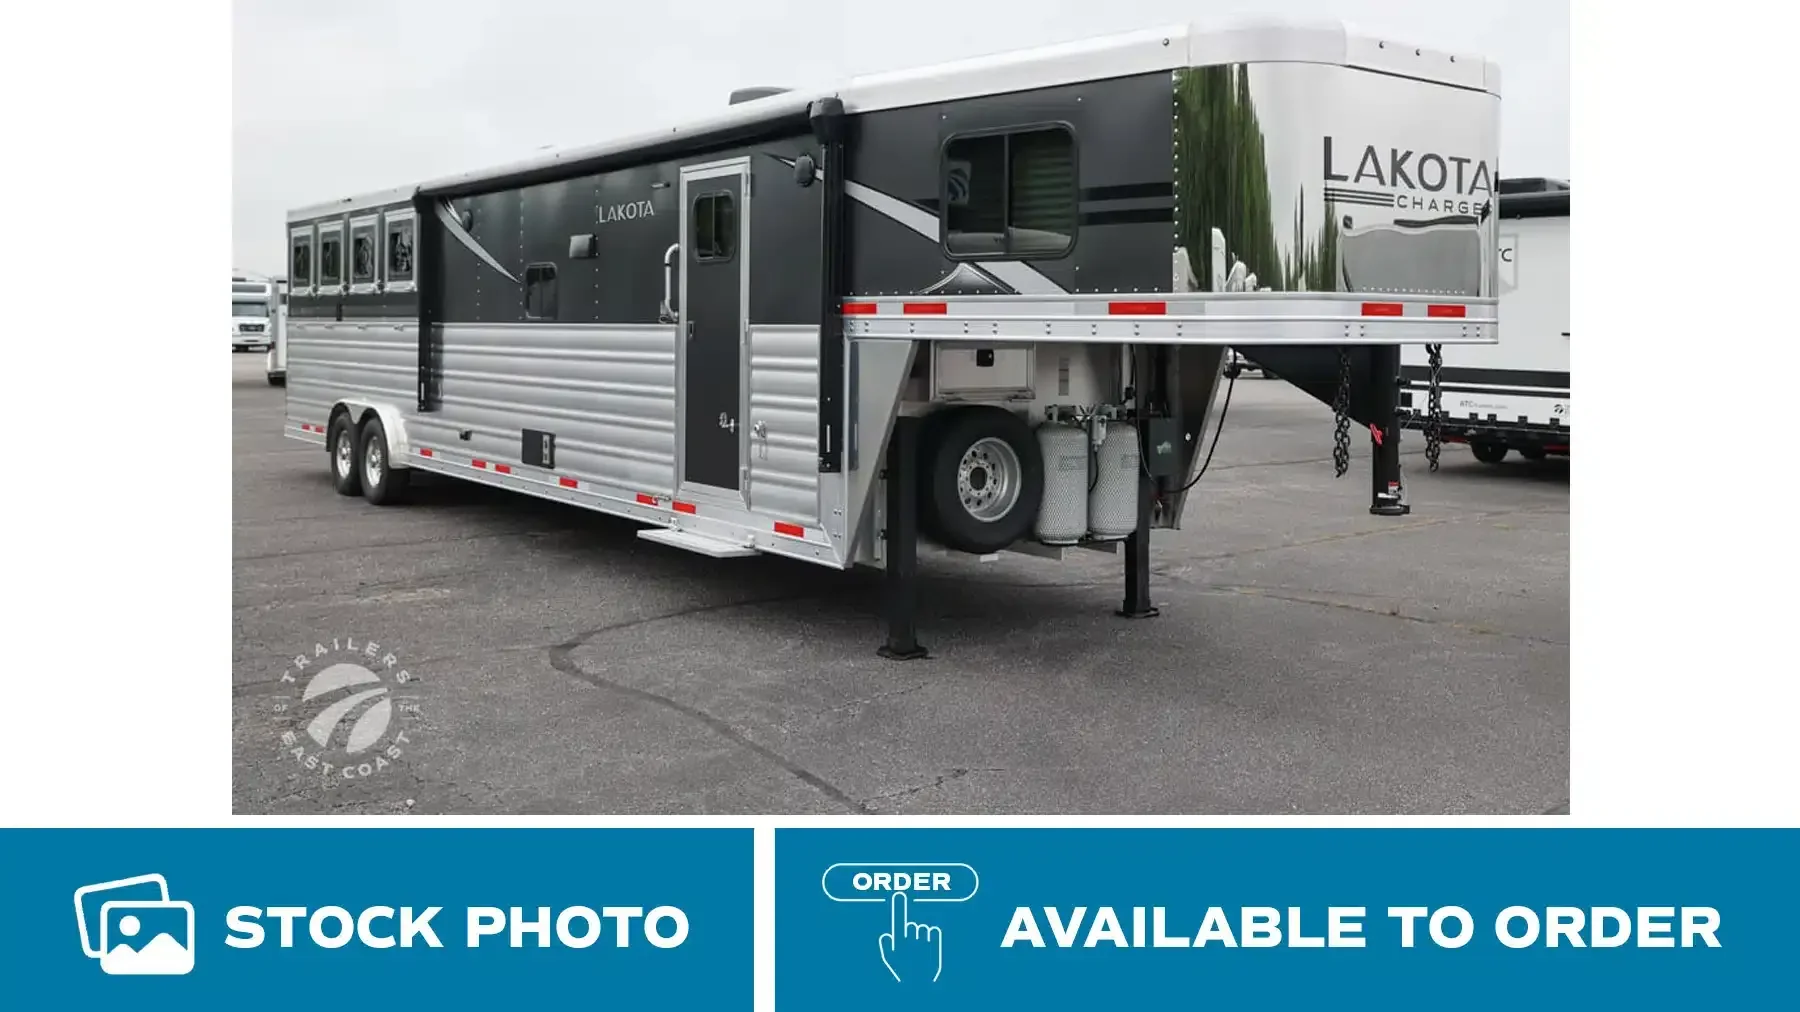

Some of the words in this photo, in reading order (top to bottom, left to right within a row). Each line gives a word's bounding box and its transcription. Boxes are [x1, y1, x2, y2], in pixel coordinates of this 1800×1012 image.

[1323, 136, 1493, 197] LAKOTA
[598, 200, 655, 223] LAKOTA
[1396, 195, 1492, 216] CHARGE
